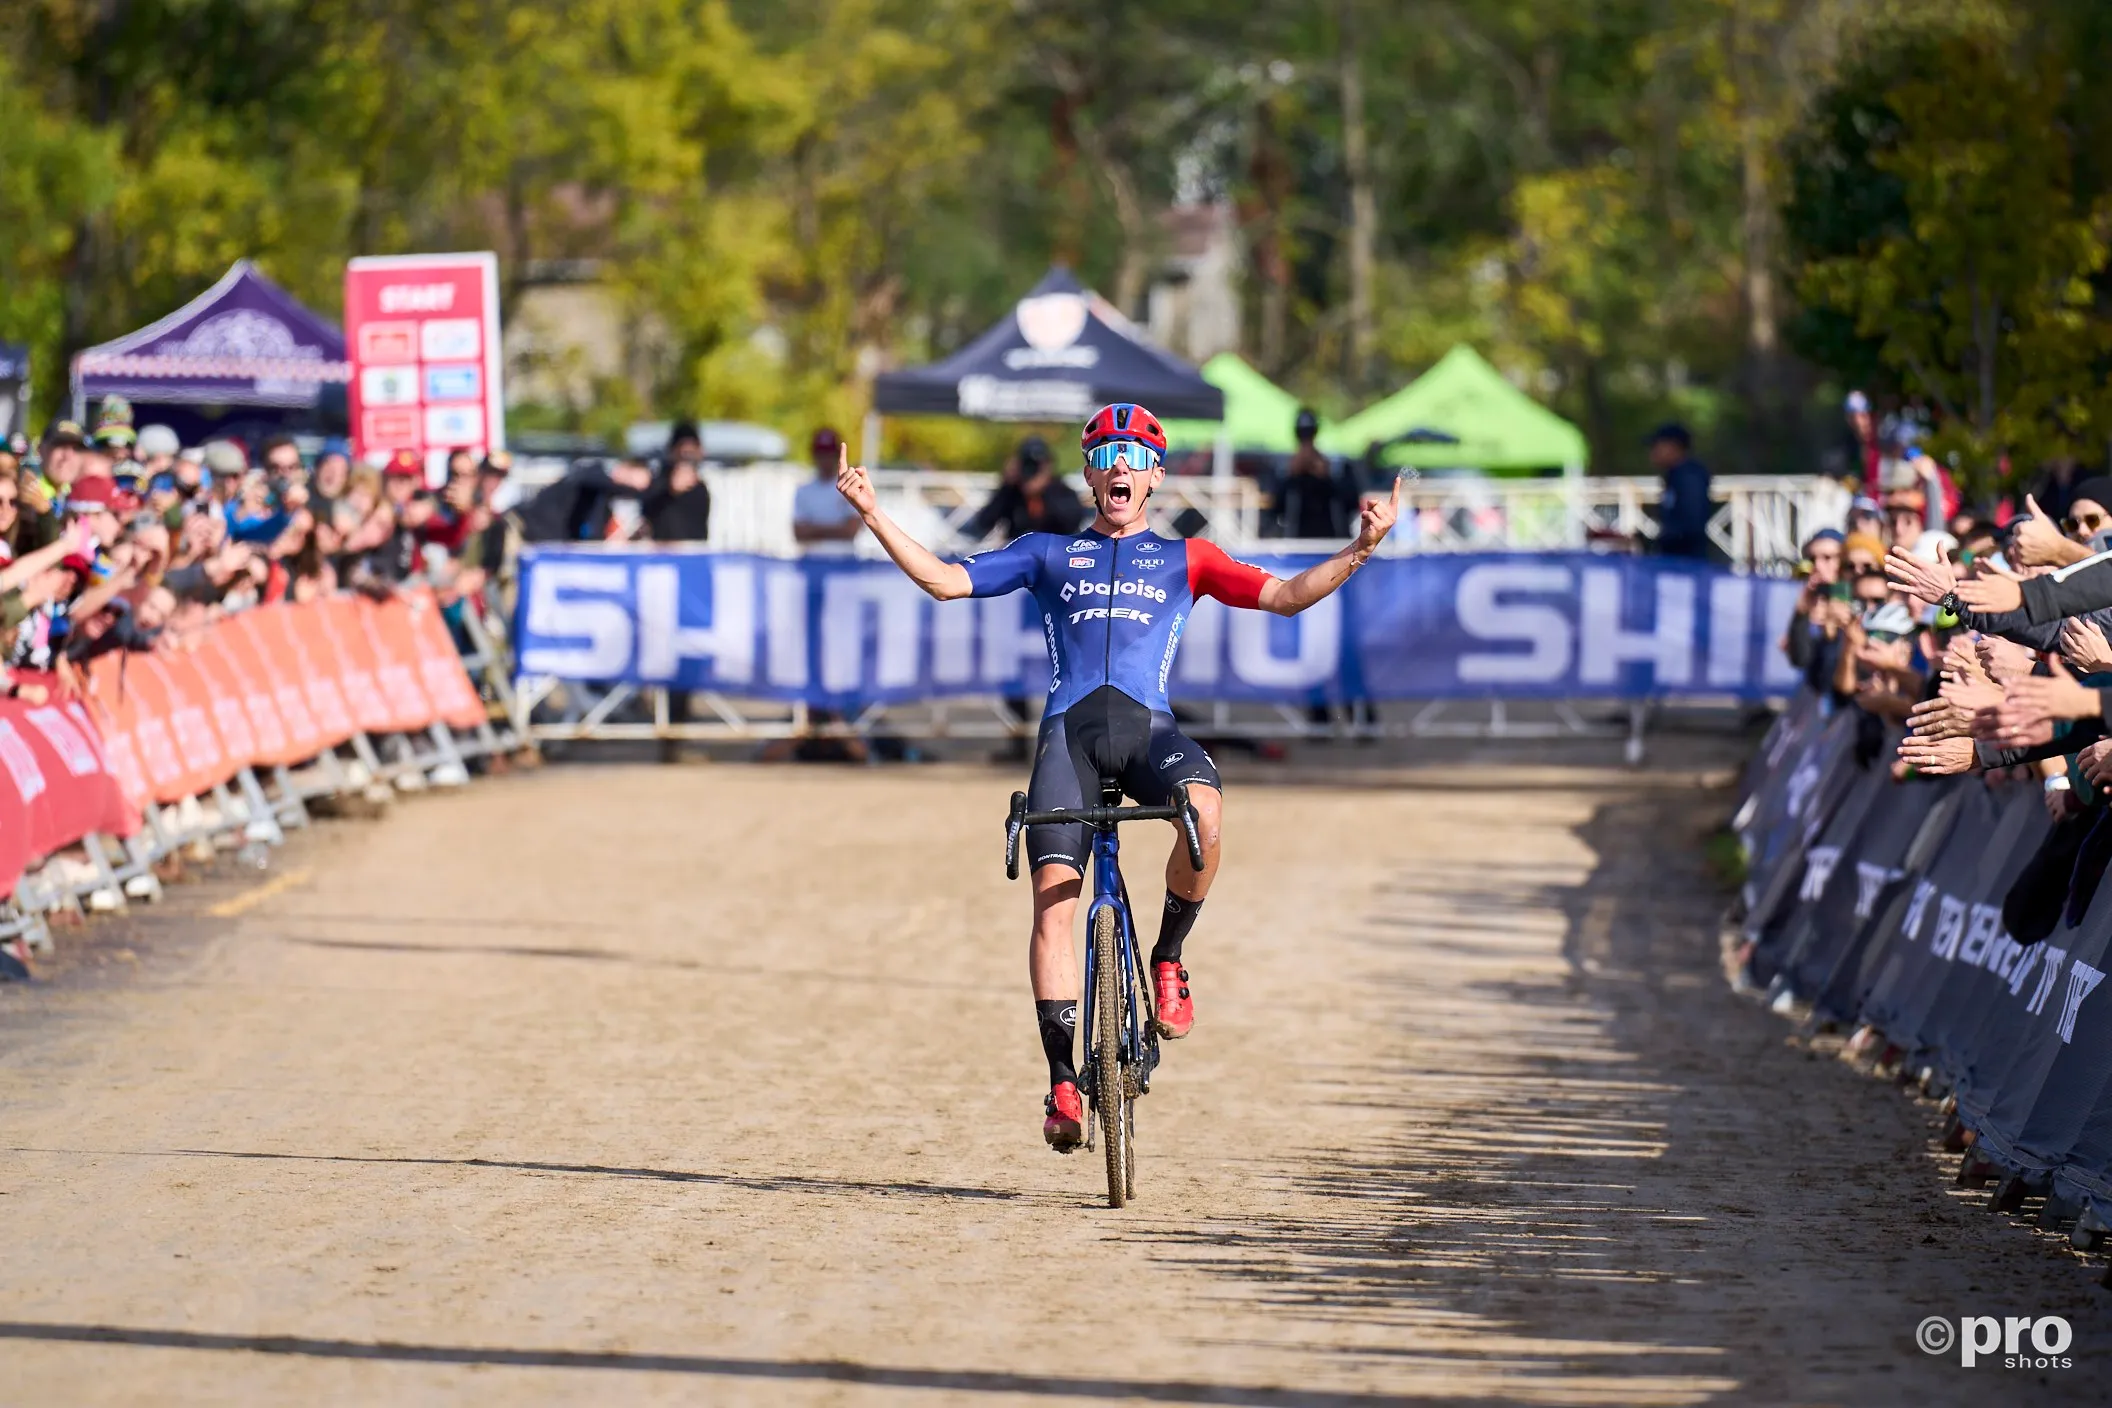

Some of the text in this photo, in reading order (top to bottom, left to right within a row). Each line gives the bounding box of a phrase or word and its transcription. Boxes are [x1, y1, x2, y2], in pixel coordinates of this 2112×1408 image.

[1079, 578, 1167, 604] baloise
[1069, 607, 1154, 625] TREK
[1044, 612, 1061, 679] baloise
[1037, 852, 1075, 862] BONTRAGER
